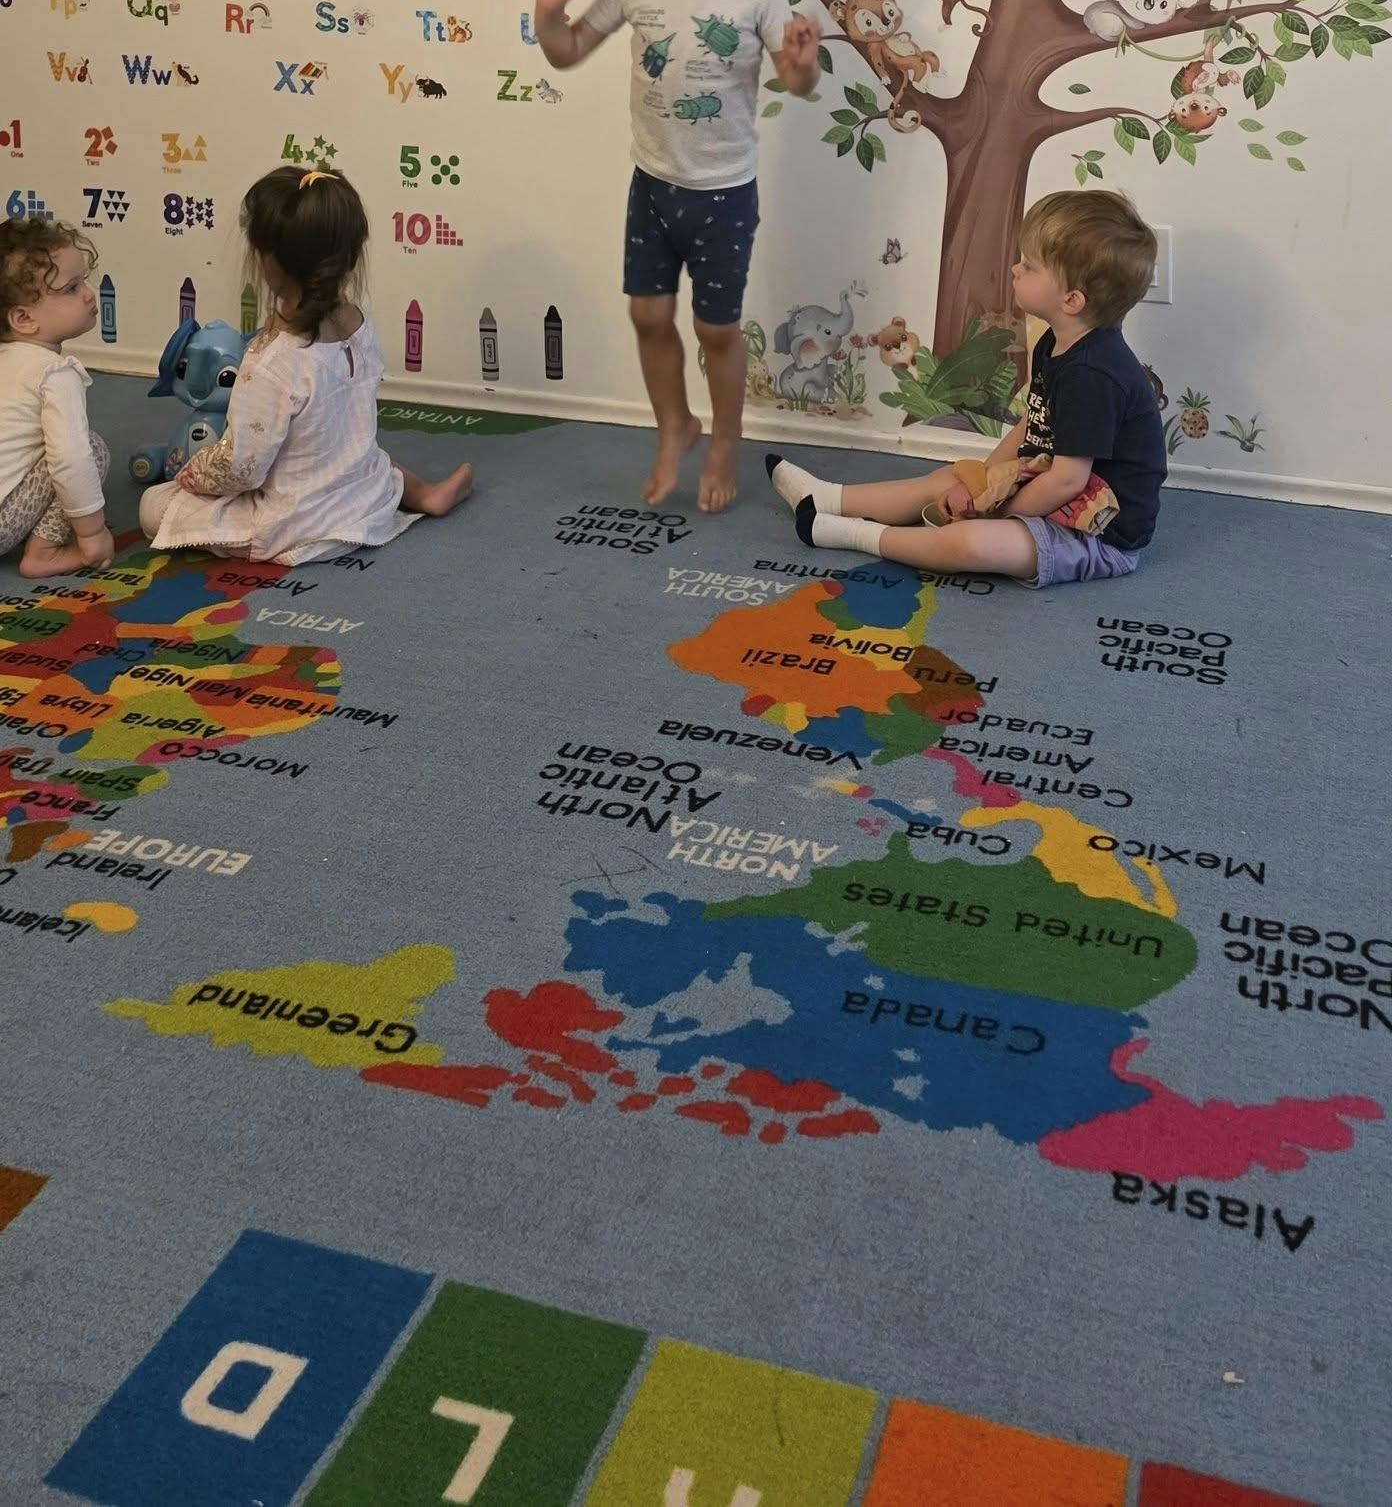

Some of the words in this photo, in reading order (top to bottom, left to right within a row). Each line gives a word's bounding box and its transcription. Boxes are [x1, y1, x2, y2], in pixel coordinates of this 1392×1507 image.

[225, 3, 254, 34] Rr
[315, 1, 349, 33] Ss
[416, 10, 446, 42] Tt
[47, 52, 77, 82] Vv
[121, 55, 172, 85] Ww
[273, 61, 315, 95] Xx
[379, 63, 413, 103] Yy
[497, 69, 533, 102] Zz
[10, 120, 21, 148] 1
[84, 127, 103, 157] 2
[162, 133, 182, 163] 3
[281, 134, 303, 163] 4
[400, 145, 421, 178] 5
[6, 190, 25, 219] 6
[83, 189, 103, 218] 7
[163, 193, 183, 224] 8
[392, 212, 431, 245] 10
[554, 514, 693, 544] Atlantic
[576, 503, 687, 527] Ocean
[554, 529, 661, 555] South
[217, 572, 318, 597] Angola
[666, 567, 795, 593] AMERICA
[752, 558, 903, 591] Argentina
[918, 572, 995, 595] Chile
[31, 585, 105, 604] Kenya
[664, 581, 769, 606] SOUTH
[257, 608, 364, 634] AFRICA
[1096, 617, 1232, 648] Ocean
[75, 642, 148, 663] Chad
[149, 639, 246, 663] Nigeria
[740, 648, 837, 677] Brazil
[808, 633, 914, 662] Bolivia
[1098, 634, 1226, 666] Pacific
[115, 666, 197, 693] Niger
[915, 666, 999, 694] Peru
[1100, 653, 1228, 685] South
[40, 694, 112, 718] Libya
[193, 680, 248, 702] Mali
[121, 712, 224, 741] Algeria
[245, 694, 398, 729] Mauritania
[937, 708, 1094, 747] Ecuador
[160, 743, 309, 778] Morocco
[657, 719, 862, 771] Venezuela
[939, 736, 1094, 775] America
[60, 768, 140, 792] Spain
[554, 742, 701, 784] Ocean
[537, 763, 722, 813] Atlantic
[981, 770, 1134, 809] Central
[19, 792, 121, 821] France
[536, 791, 671, 833] North
[82, 830, 252, 876] EUROPE
[667, 814, 839, 862] AMERICA
[906, 821, 1012, 856] Cuba
[45, 851, 172, 891] Ireland
[665, 842, 800, 881] NORTH
[1088, 835, 1266, 886] Mexico
[841, 881, 990, 928] States
[1014, 911, 1164, 960] United
[1224, 941, 1392, 998] Pacific
[188, 984, 418, 1054] Greenland
[1238, 976, 1392, 1032] North
[839, 990, 1045, 1055] Canada
[1111, 1170, 1315, 1253] Alaska
[180, 1341, 310, 1440] D
[431, 1395, 516, 1505] L
